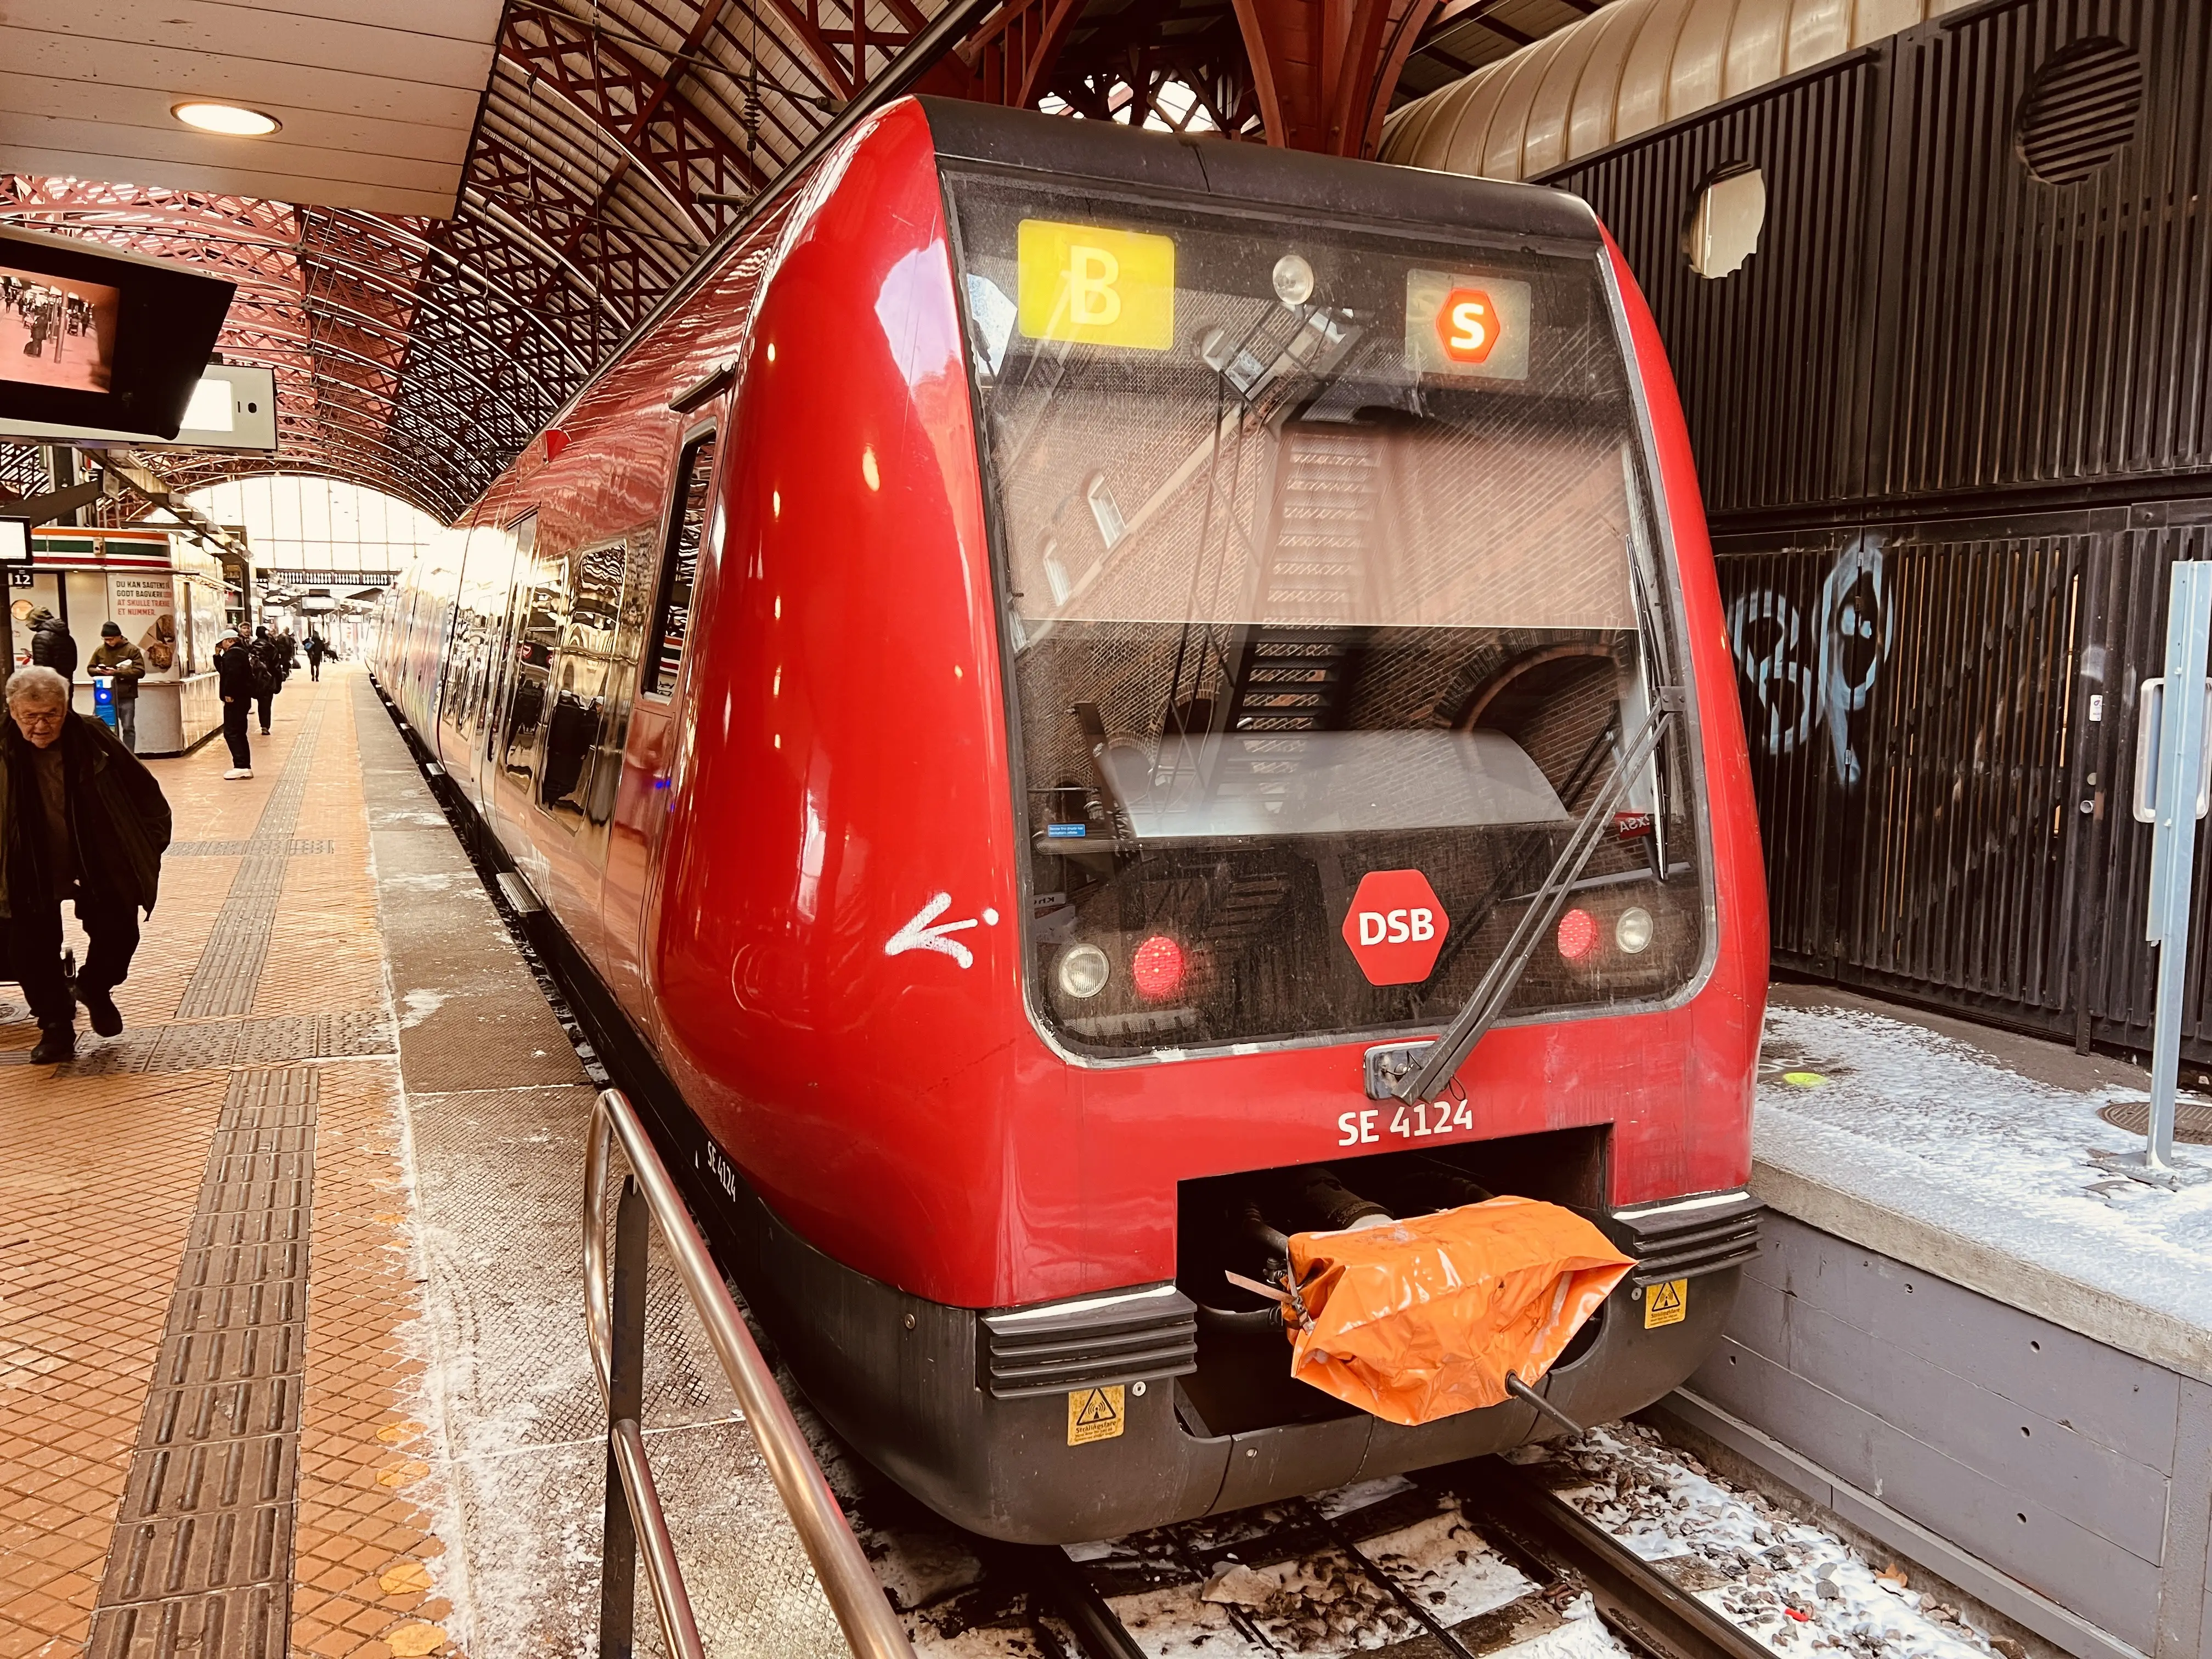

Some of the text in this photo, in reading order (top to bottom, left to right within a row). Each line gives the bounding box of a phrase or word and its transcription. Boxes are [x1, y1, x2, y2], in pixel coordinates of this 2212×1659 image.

[1070, 245, 1121, 325] B
[1451, 303, 1485, 349] S
[15, 575, 31, 584] 12
[1359, 908, 1435, 946] DSB
[1338, 1099, 1474, 1146] SE 4124
[708, 1141, 736, 1202] SE 4124
